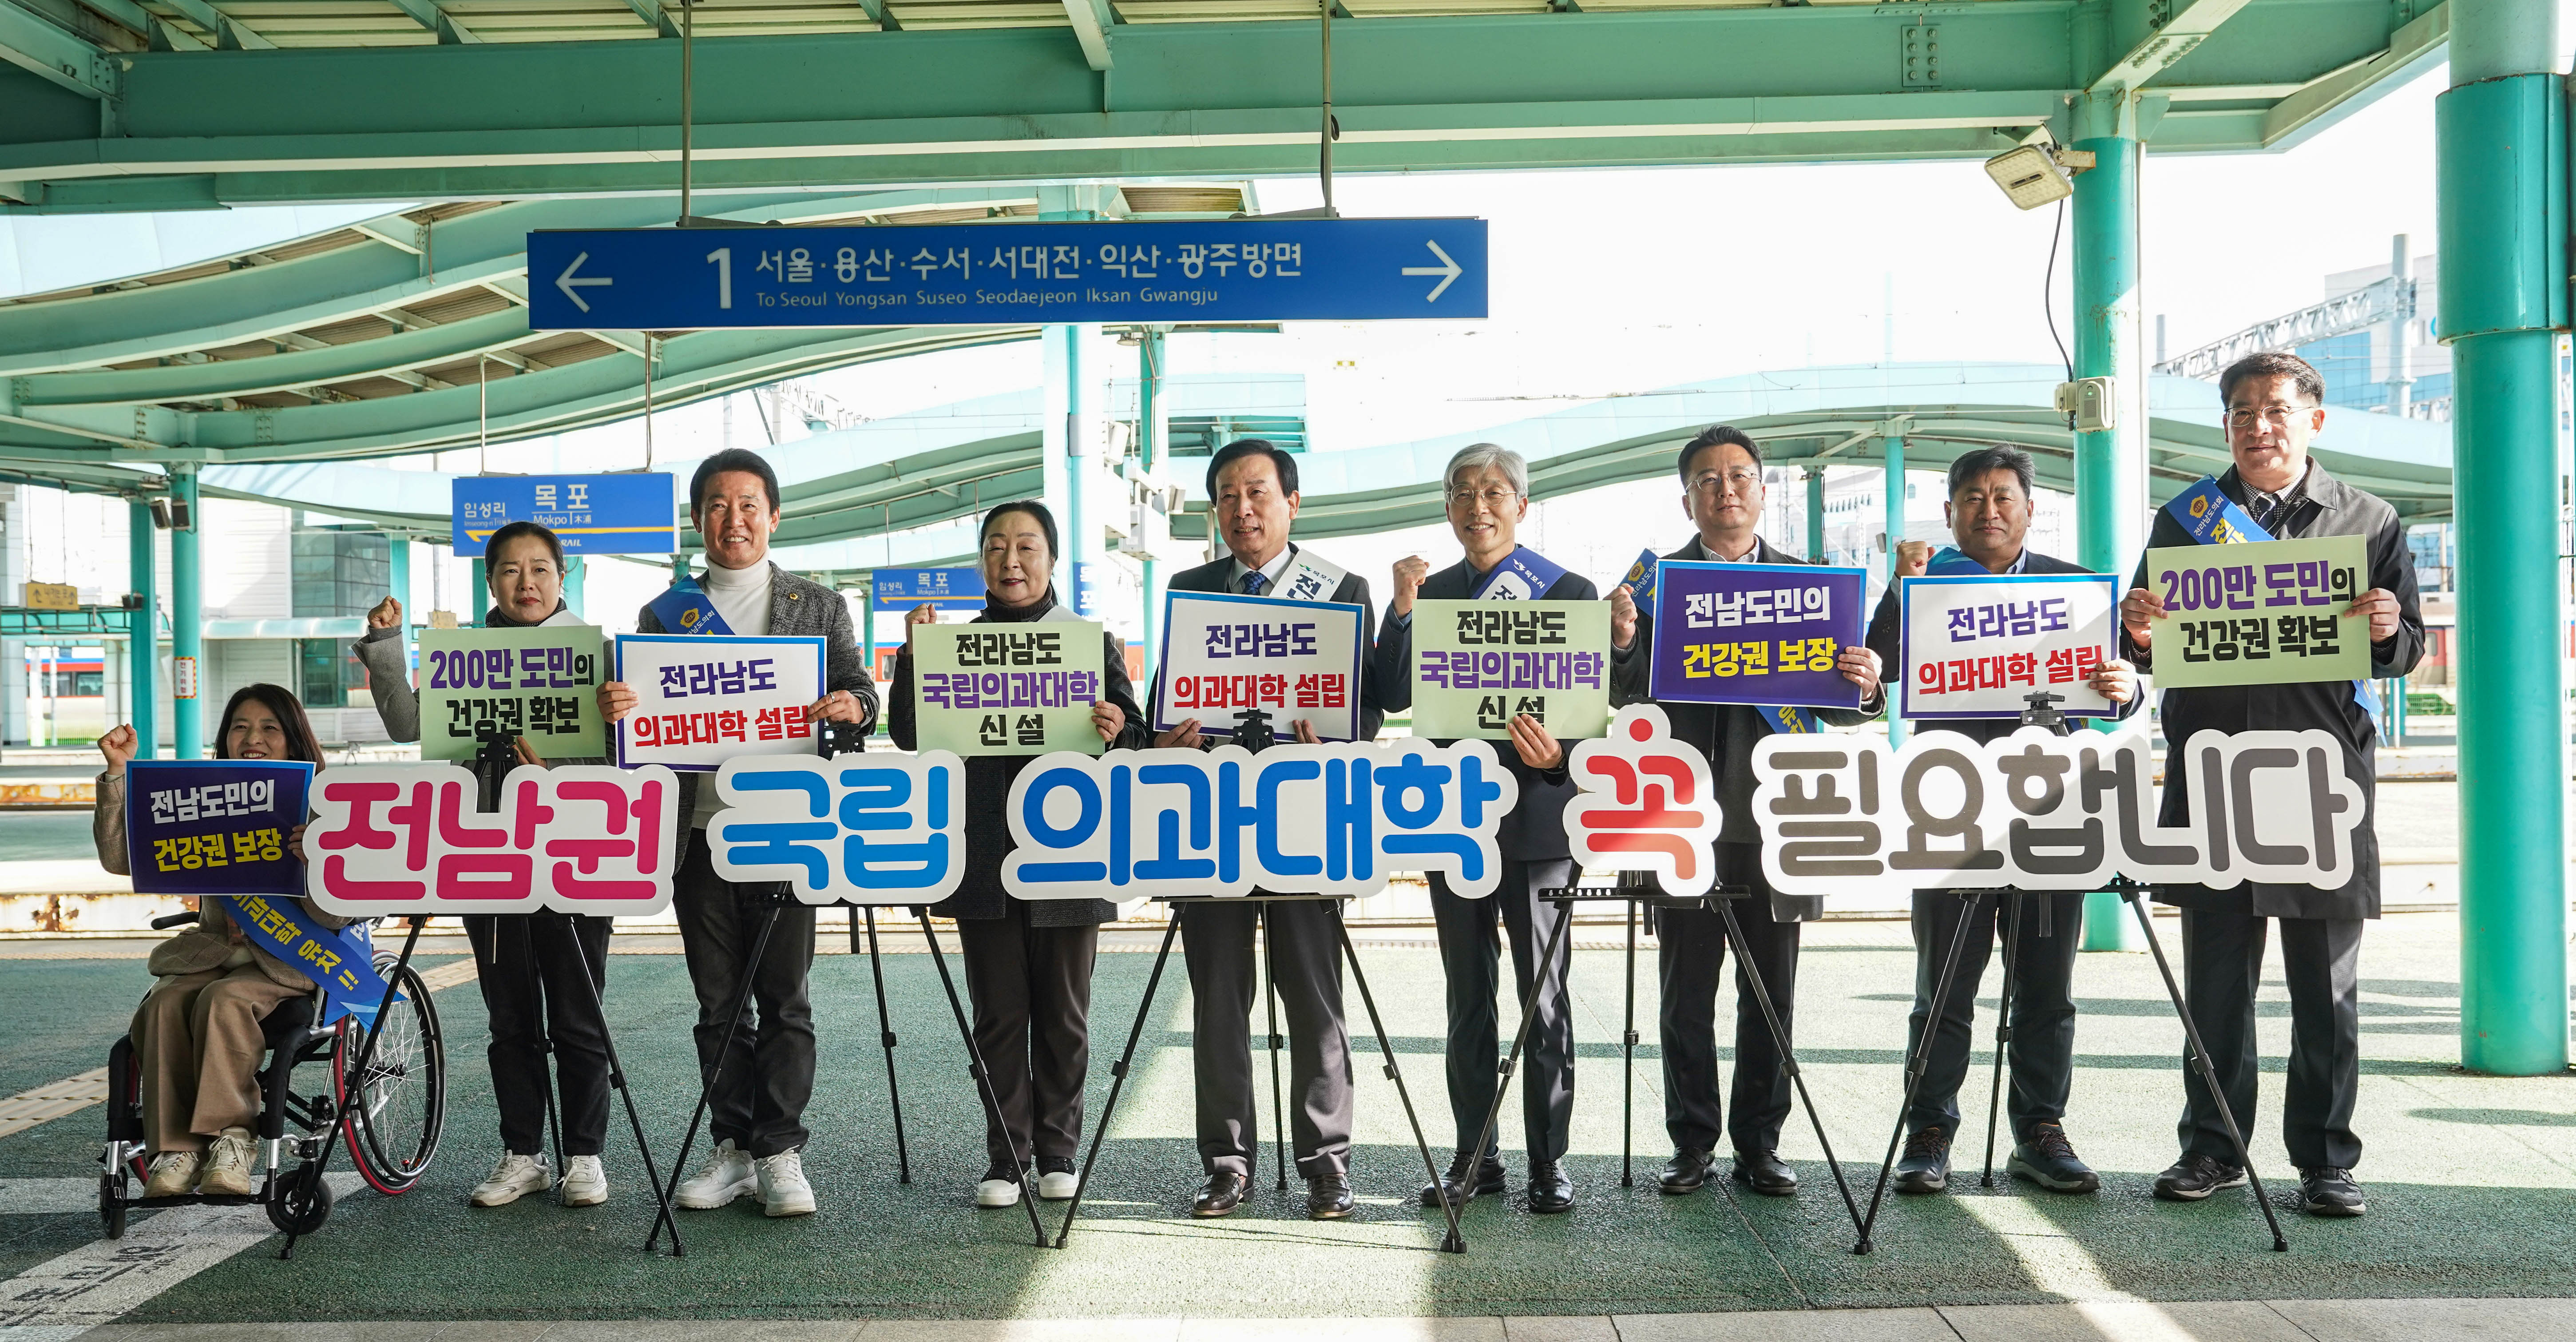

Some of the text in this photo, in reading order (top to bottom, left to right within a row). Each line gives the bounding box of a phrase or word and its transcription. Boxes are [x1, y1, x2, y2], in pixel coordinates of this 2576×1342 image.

[708, 248, 732, 309] 1
[756, 287, 1218, 310] To Seoul Yongsan Suseo Seodaejeon Iksan Gwangju
[464, 502, 506, 518] 임성리
[533, 514, 567, 527] Mokpo
[2194, 495, 2224, 536] 전라남도의회
[879, 582, 903, 591] 임성리
[1312, 570, 1335, 585] 목포시
[1524, 569, 1546, 589] 목포시
[2160, 560, 2356, 611] 200만 도민의
[686, 610, 715, 635] 남도의회
[1457, 610, 1566, 645] 전라남도
[1685, 586, 1831, 629] 전남도민의
[1948, 598, 2069, 643] 전라남도
[956, 632, 1062, 667] 전라남도
[1207, 623, 1317, 659] 전라남도
[1683, 637, 1837, 679] 건강권 보장
[2180, 615, 2340, 663] 건강권 확보
[430, 647, 594, 690] 200만 도민의
[659, 658, 777, 699] 전라남도
[1420, 651, 1604, 690] 국립의과대학
[1918, 645, 2103, 695] 의과대학 설립
[923, 671, 1099, 709] 국립의과대학
[1173, 673, 1345, 709] 의과대학 설립
[446, 695, 580, 738] 건강권 확보
[634, 705, 811, 747] 의과대학 설립
[150, 779, 275, 824] 전남도민의
[318, 718, 2349, 901] 전남권 국립 의과대학 꼭 필요합니다
[153, 828, 283, 872] 건강권 보장
[298, 939, 342, 975] 유치
